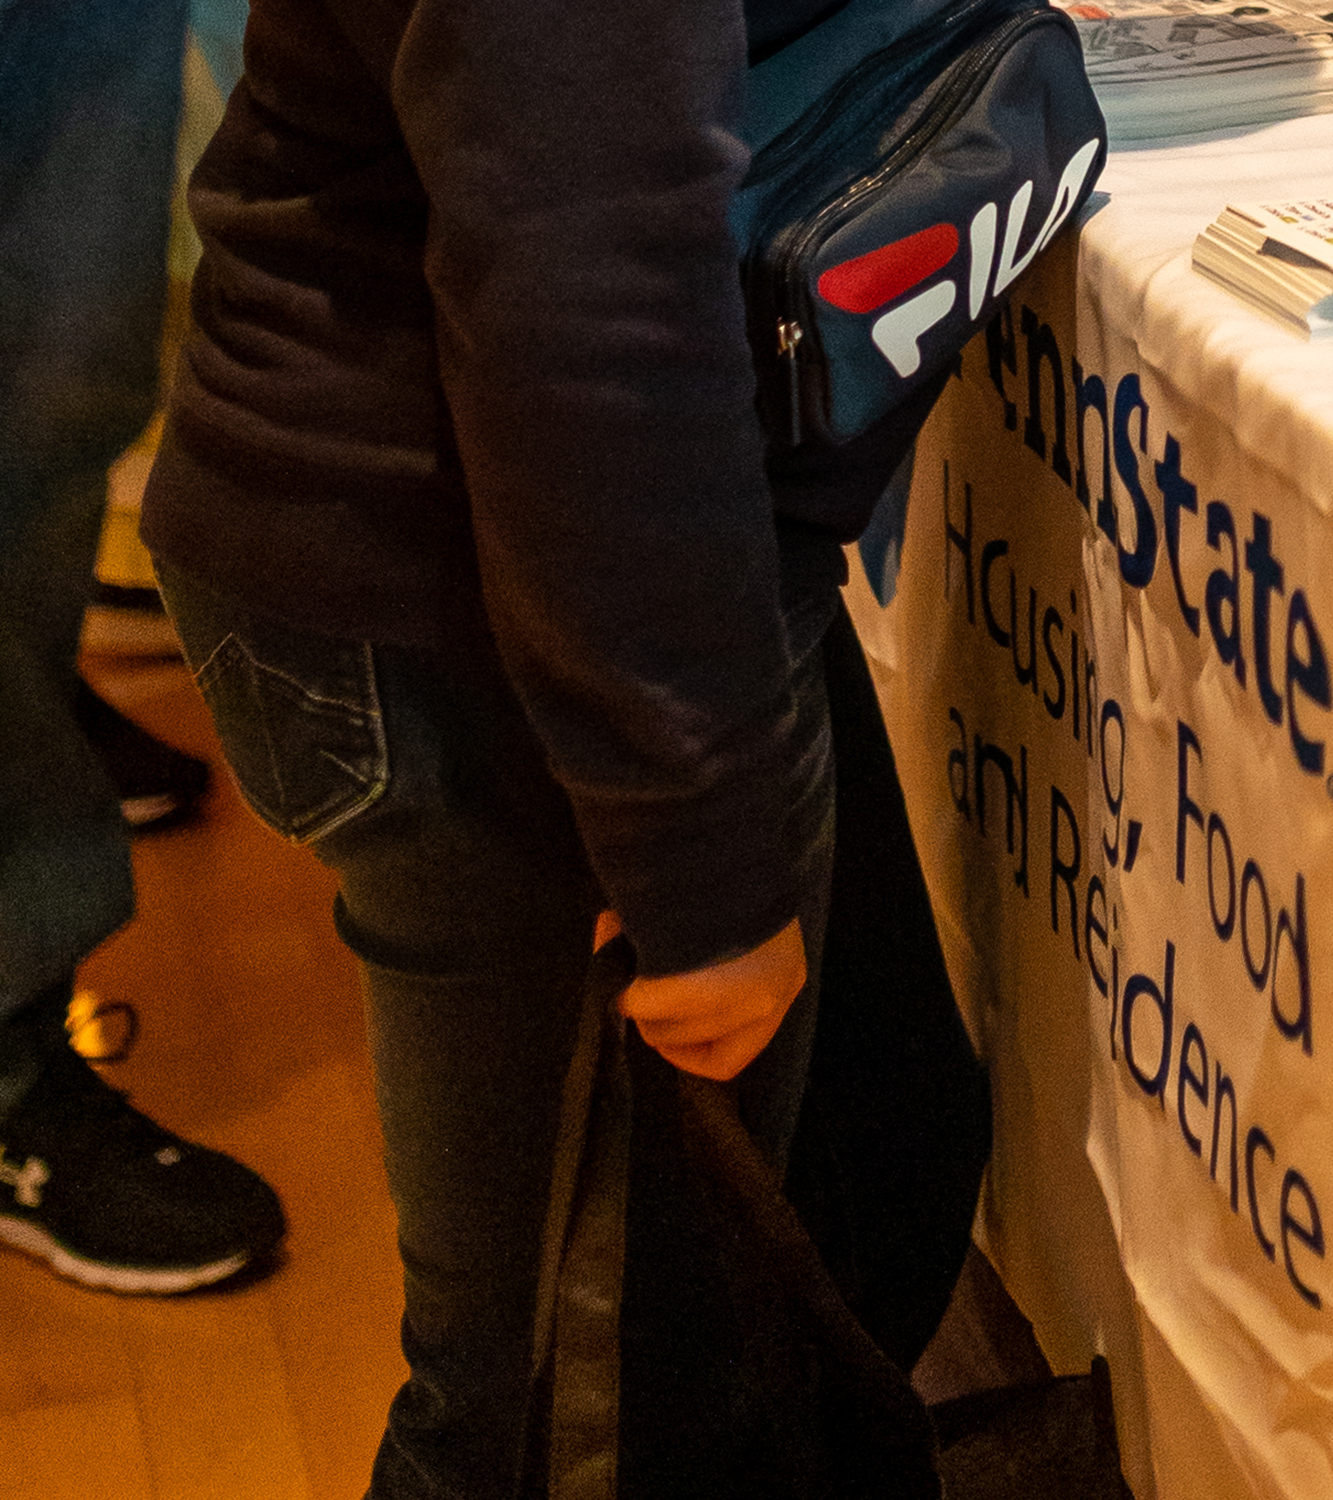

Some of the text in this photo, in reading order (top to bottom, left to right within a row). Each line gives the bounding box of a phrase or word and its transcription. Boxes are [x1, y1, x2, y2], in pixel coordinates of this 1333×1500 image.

[817, 137, 1101, 379] FILA
[984, 296, 1333, 777] ennState
[1050, 784, 1325, 1311] Reidence
[1176, 719, 1314, 1057] Food
